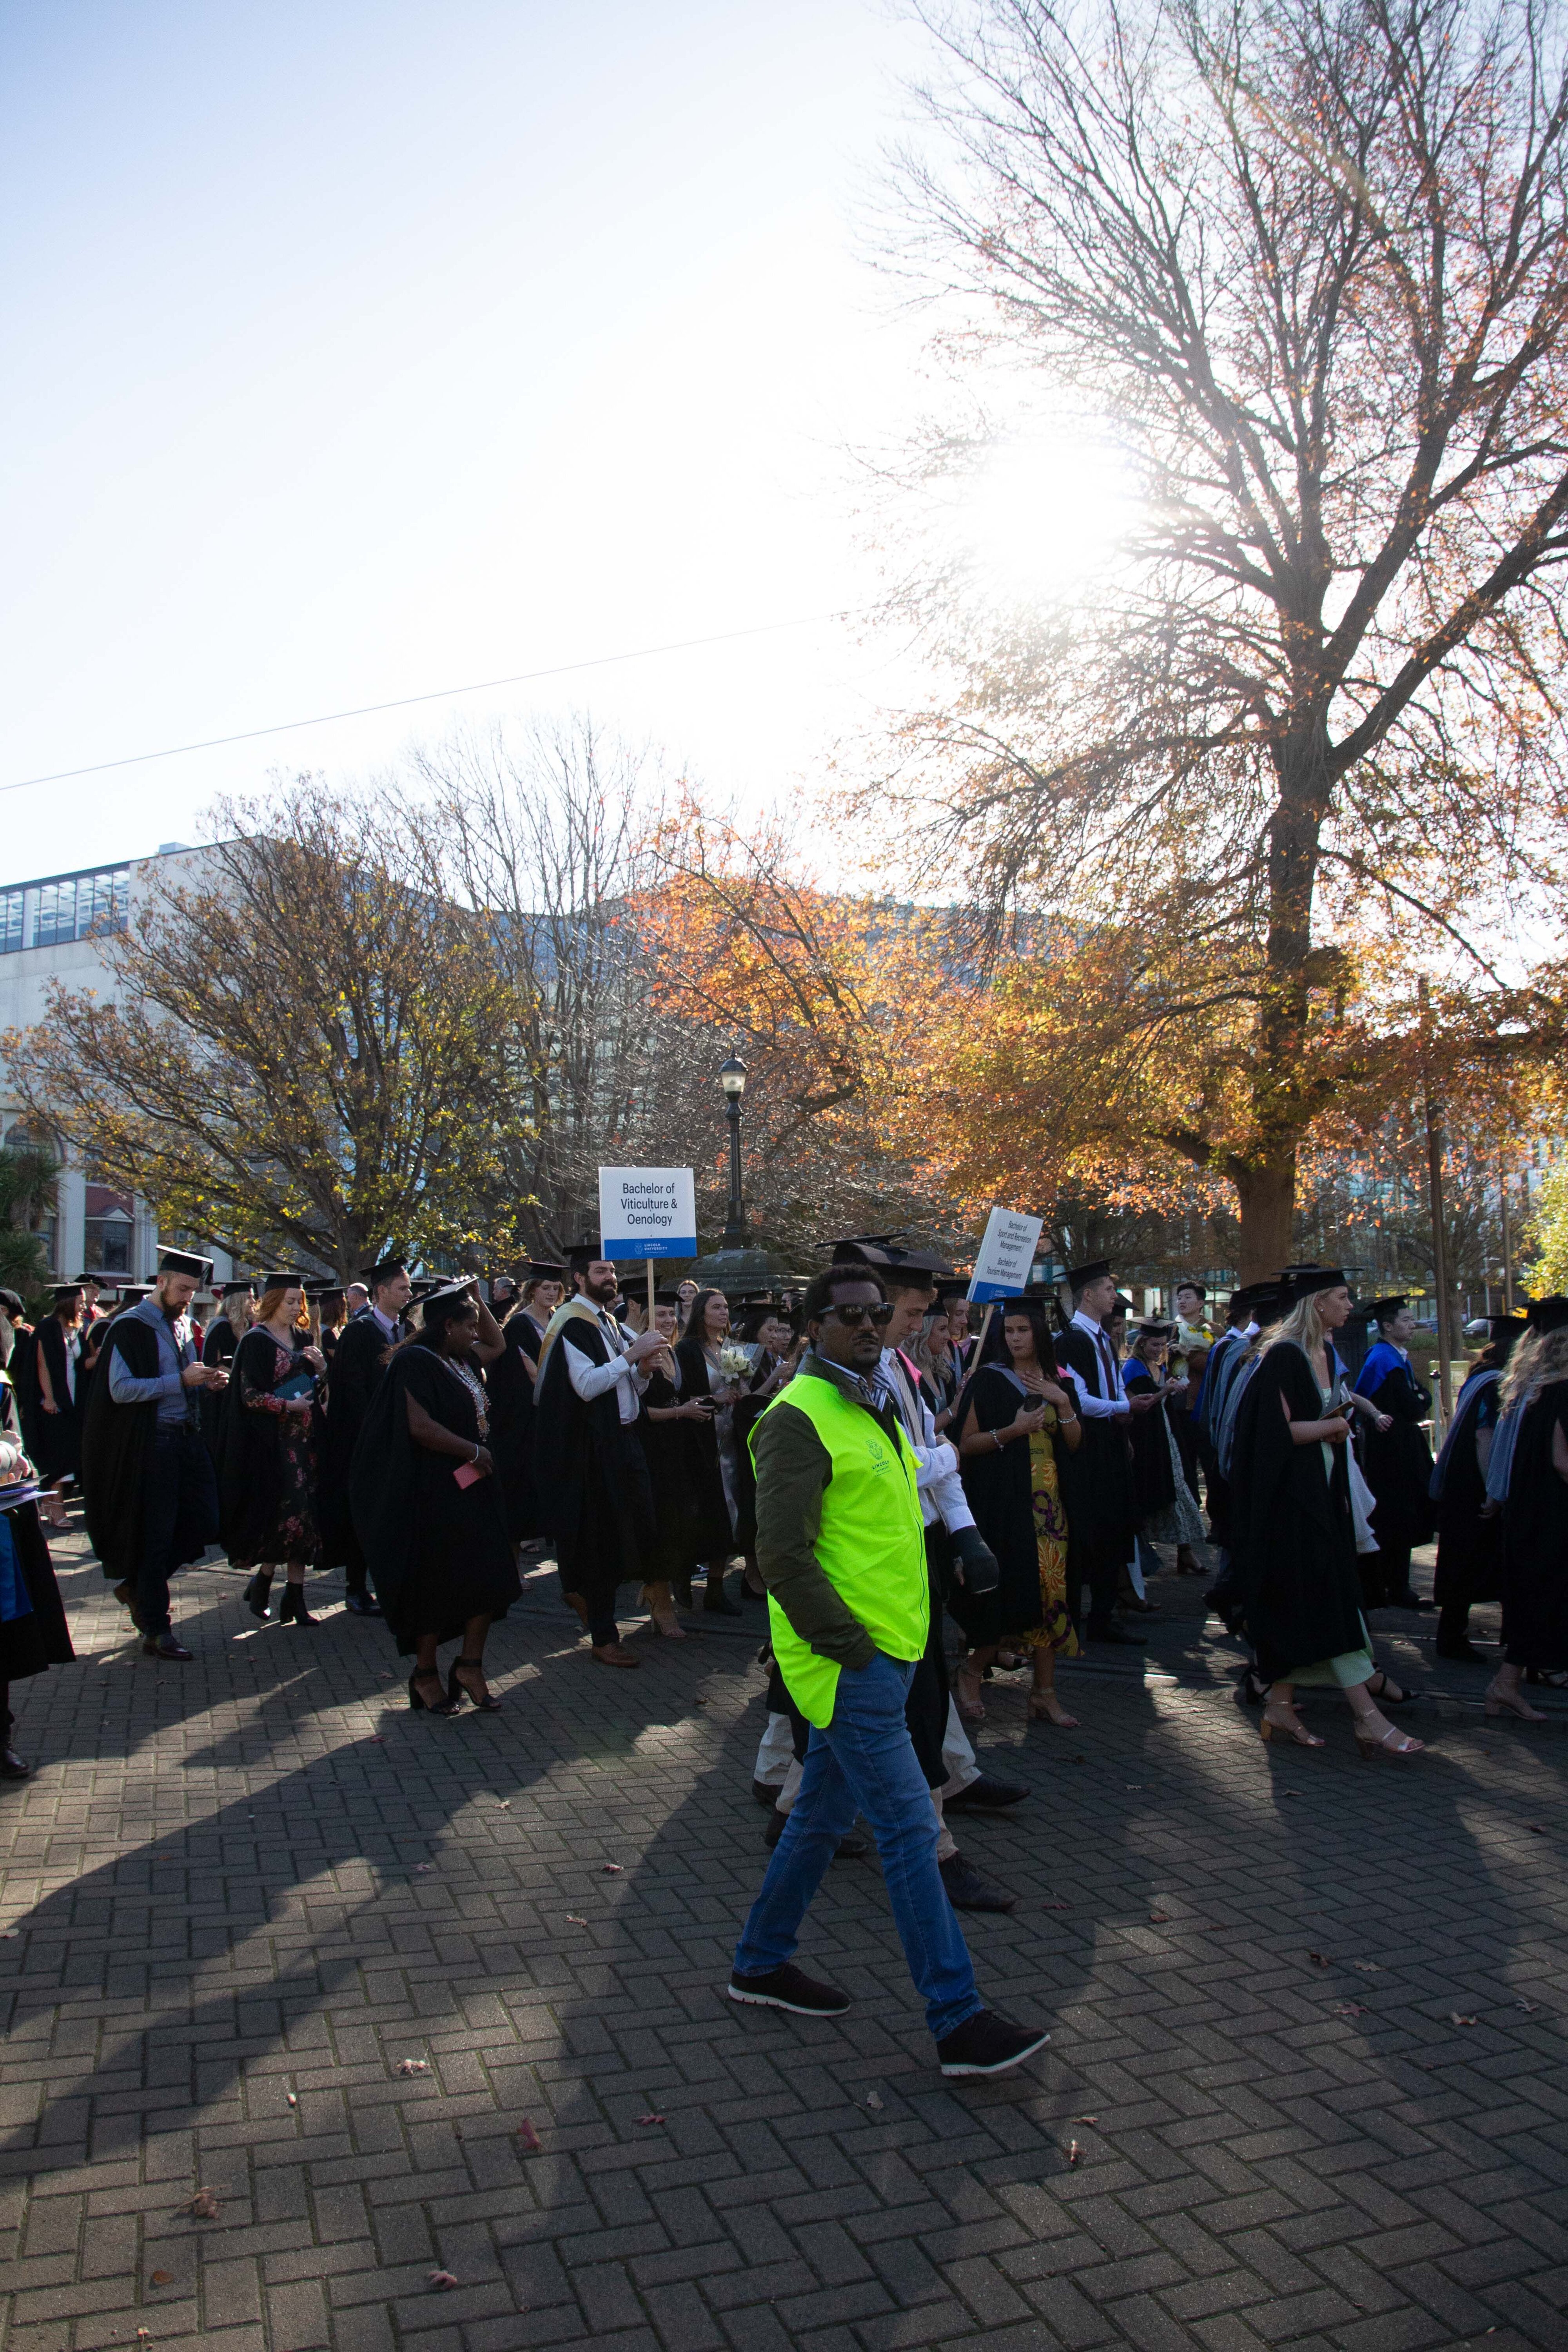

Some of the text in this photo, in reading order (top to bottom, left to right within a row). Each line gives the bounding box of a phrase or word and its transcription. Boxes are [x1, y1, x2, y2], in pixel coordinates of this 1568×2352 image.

[623, 1183, 675, 1194] Bachelor of
[621, 1198, 677, 1209] Viticulture &
[628, 1213, 672, 1226] Oenology
[1008, 1220, 1028, 1232] Bachelor of
[997, 1229, 1008, 1238] Sport
[1014, 1233, 1032, 1244] Recreation
[1000, 1240, 1022, 1252] Management
[997, 1257, 1013, 1267] Bachelor
[987, 1266, 1022, 1280] Tourism Management
